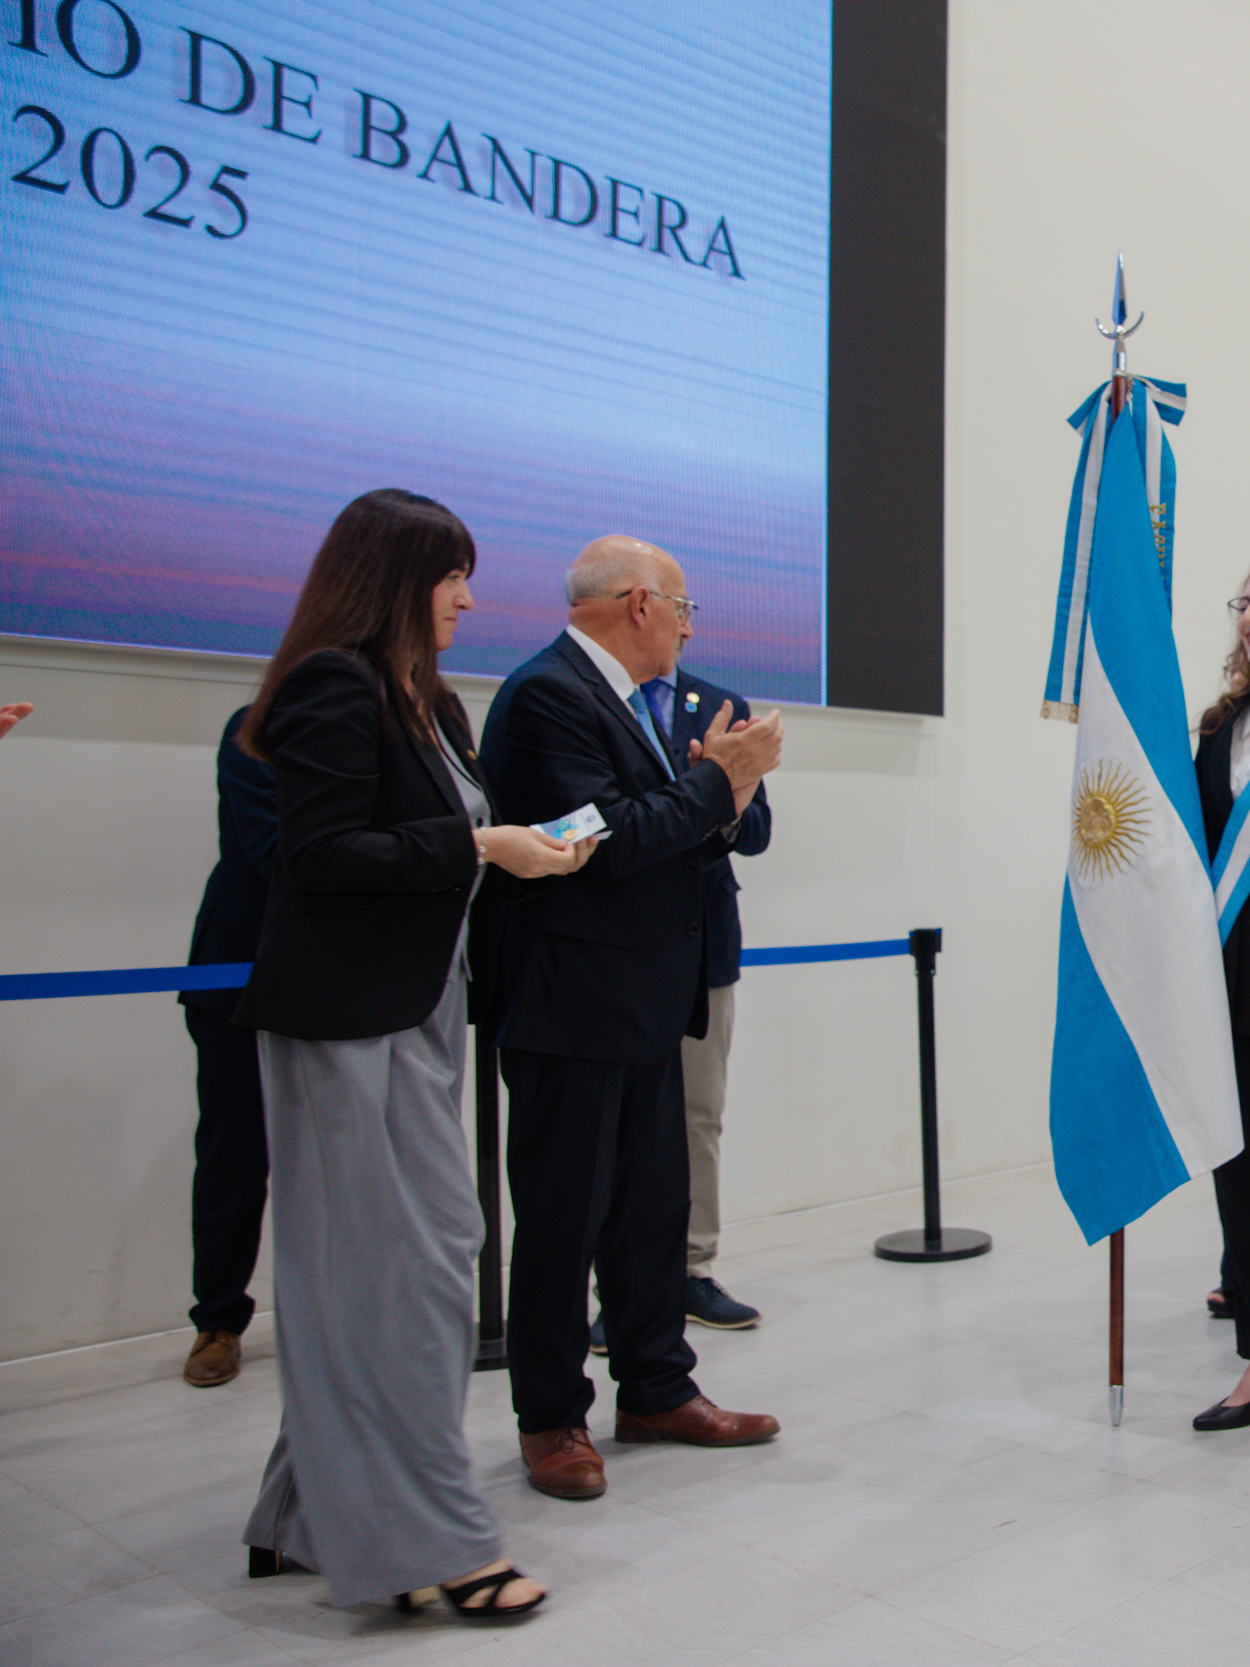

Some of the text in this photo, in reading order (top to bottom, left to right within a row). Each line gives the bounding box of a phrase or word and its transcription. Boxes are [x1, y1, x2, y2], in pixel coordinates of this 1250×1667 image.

[11, 104, 249, 239] 2025
[179, 26, 322, 144] DE
[351, 88, 746, 281] BANDERA
